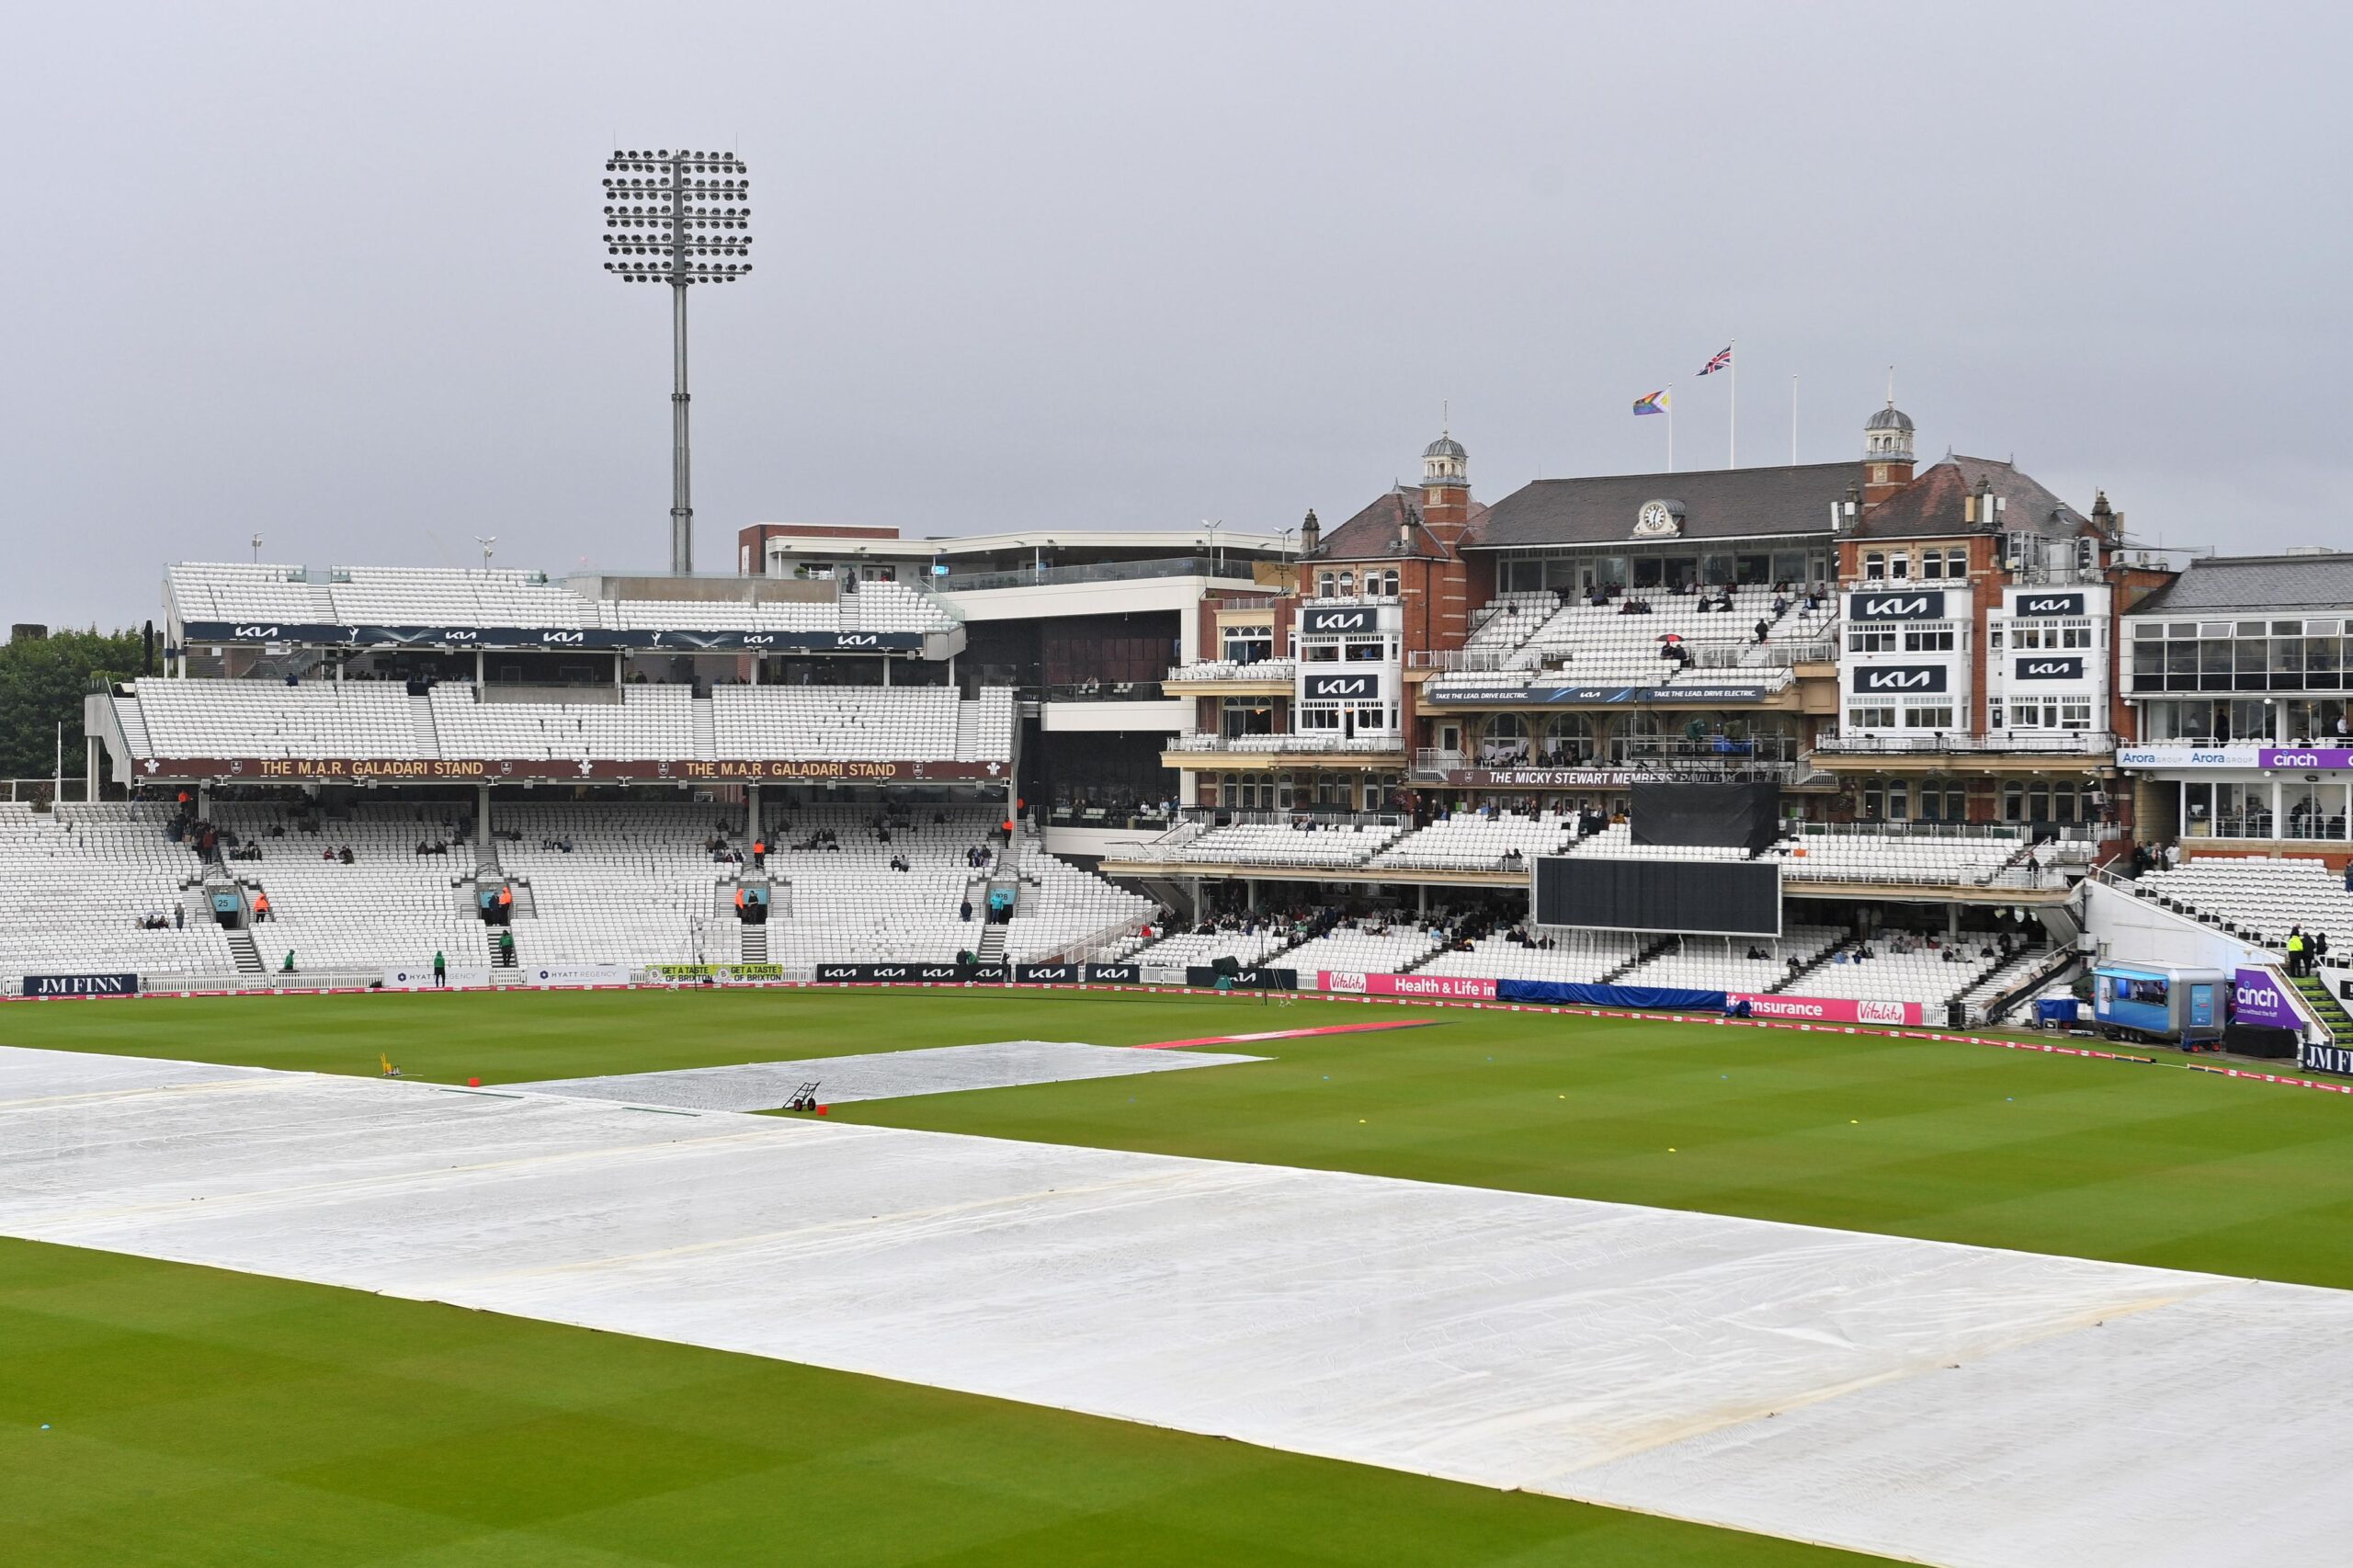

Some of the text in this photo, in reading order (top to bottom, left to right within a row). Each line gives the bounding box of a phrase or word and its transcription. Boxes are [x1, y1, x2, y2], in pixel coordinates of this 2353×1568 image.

[1867, 597, 1927, 615] KIA
[2029, 599, 2070, 611] KIA
[1316, 613, 1364, 629] KIA
[235, 627, 278, 637] KIA
[446, 631, 477, 640] KIA
[543, 631, 584, 642] KIA
[743, 633, 774, 644] KIA
[837, 634, 877, 645] KIA
[2029, 663, 2069, 674] KIA
[1870, 671, 1930, 687] KIA
[1318, 679, 1365, 694] KIA
[2122, 753, 2155, 763] Arora
[2191, 752, 2225, 763] Arora
[2273, 750, 2318, 766] cinch
[261, 761, 483, 775] THE M.A.R. GALADARI STAND
[687, 763, 896, 776] THE M.A.R. GALADARI STAND
[1489, 771, 1513, 783] THE
[1515, 772, 1552, 784] MICKY
[1554, 772, 1610, 784] STEWART
[218, 899, 229, 907] 25
[662, 966, 709, 974] GET A TASTE
[731, 966, 777, 974] GET A TASTE
[824, 968, 857, 978] KIA
[873, 968, 906, 977] KIA
[922, 968, 954, 978] KIA
[1029, 968, 1066, 979] KIA
[1096, 968, 1129, 979] KIA
[665, 974, 676, 983] OF
[747, 973, 781, 982] BRIXTON
[1230, 971, 1256, 983] IA
[1332, 972, 1365, 991] Vitality
[38, 976, 123, 994] JM FINN
[1394, 977, 1439, 994] Health
[1442, 982, 1451, 994] &
[1454, 981, 1480, 995] Life
[2236, 980, 2279, 1008] cinch
[1749, 996, 1824, 1017] insurance
[1859, 1001, 1903, 1023] Vitality
[2306, 1045, 2333, 1071] JM
